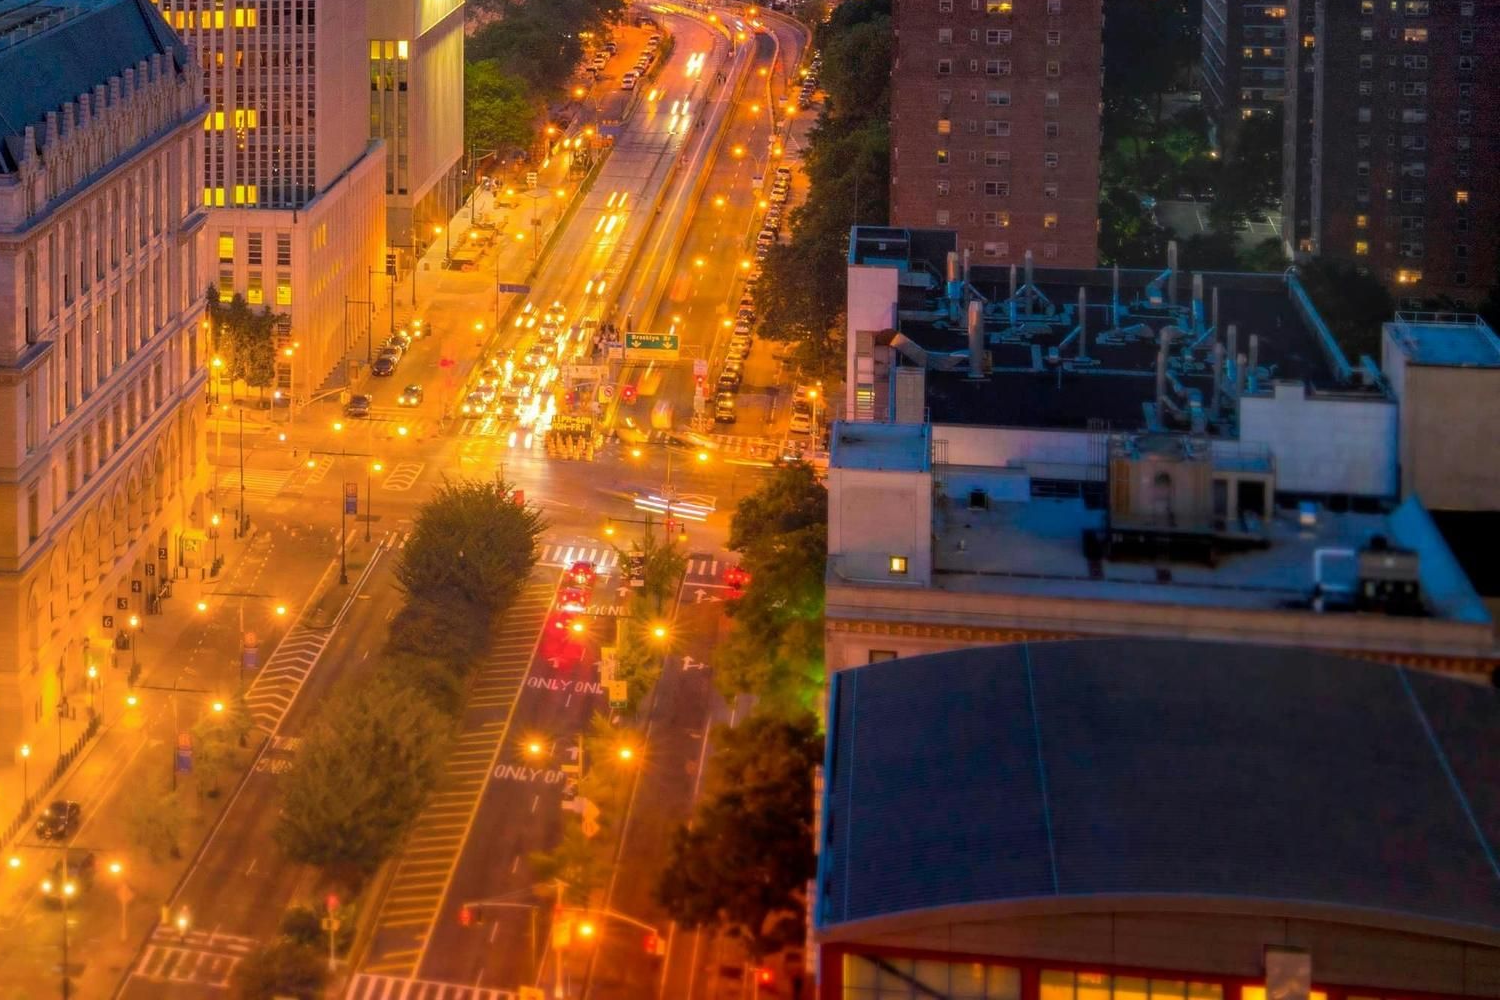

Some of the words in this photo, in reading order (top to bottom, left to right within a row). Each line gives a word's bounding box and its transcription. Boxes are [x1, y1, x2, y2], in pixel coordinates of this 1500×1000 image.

[527, 676, 573, 691] ONLY
[574, 681, 604, 694] ONL
[494, 764, 543, 781] ONLY
